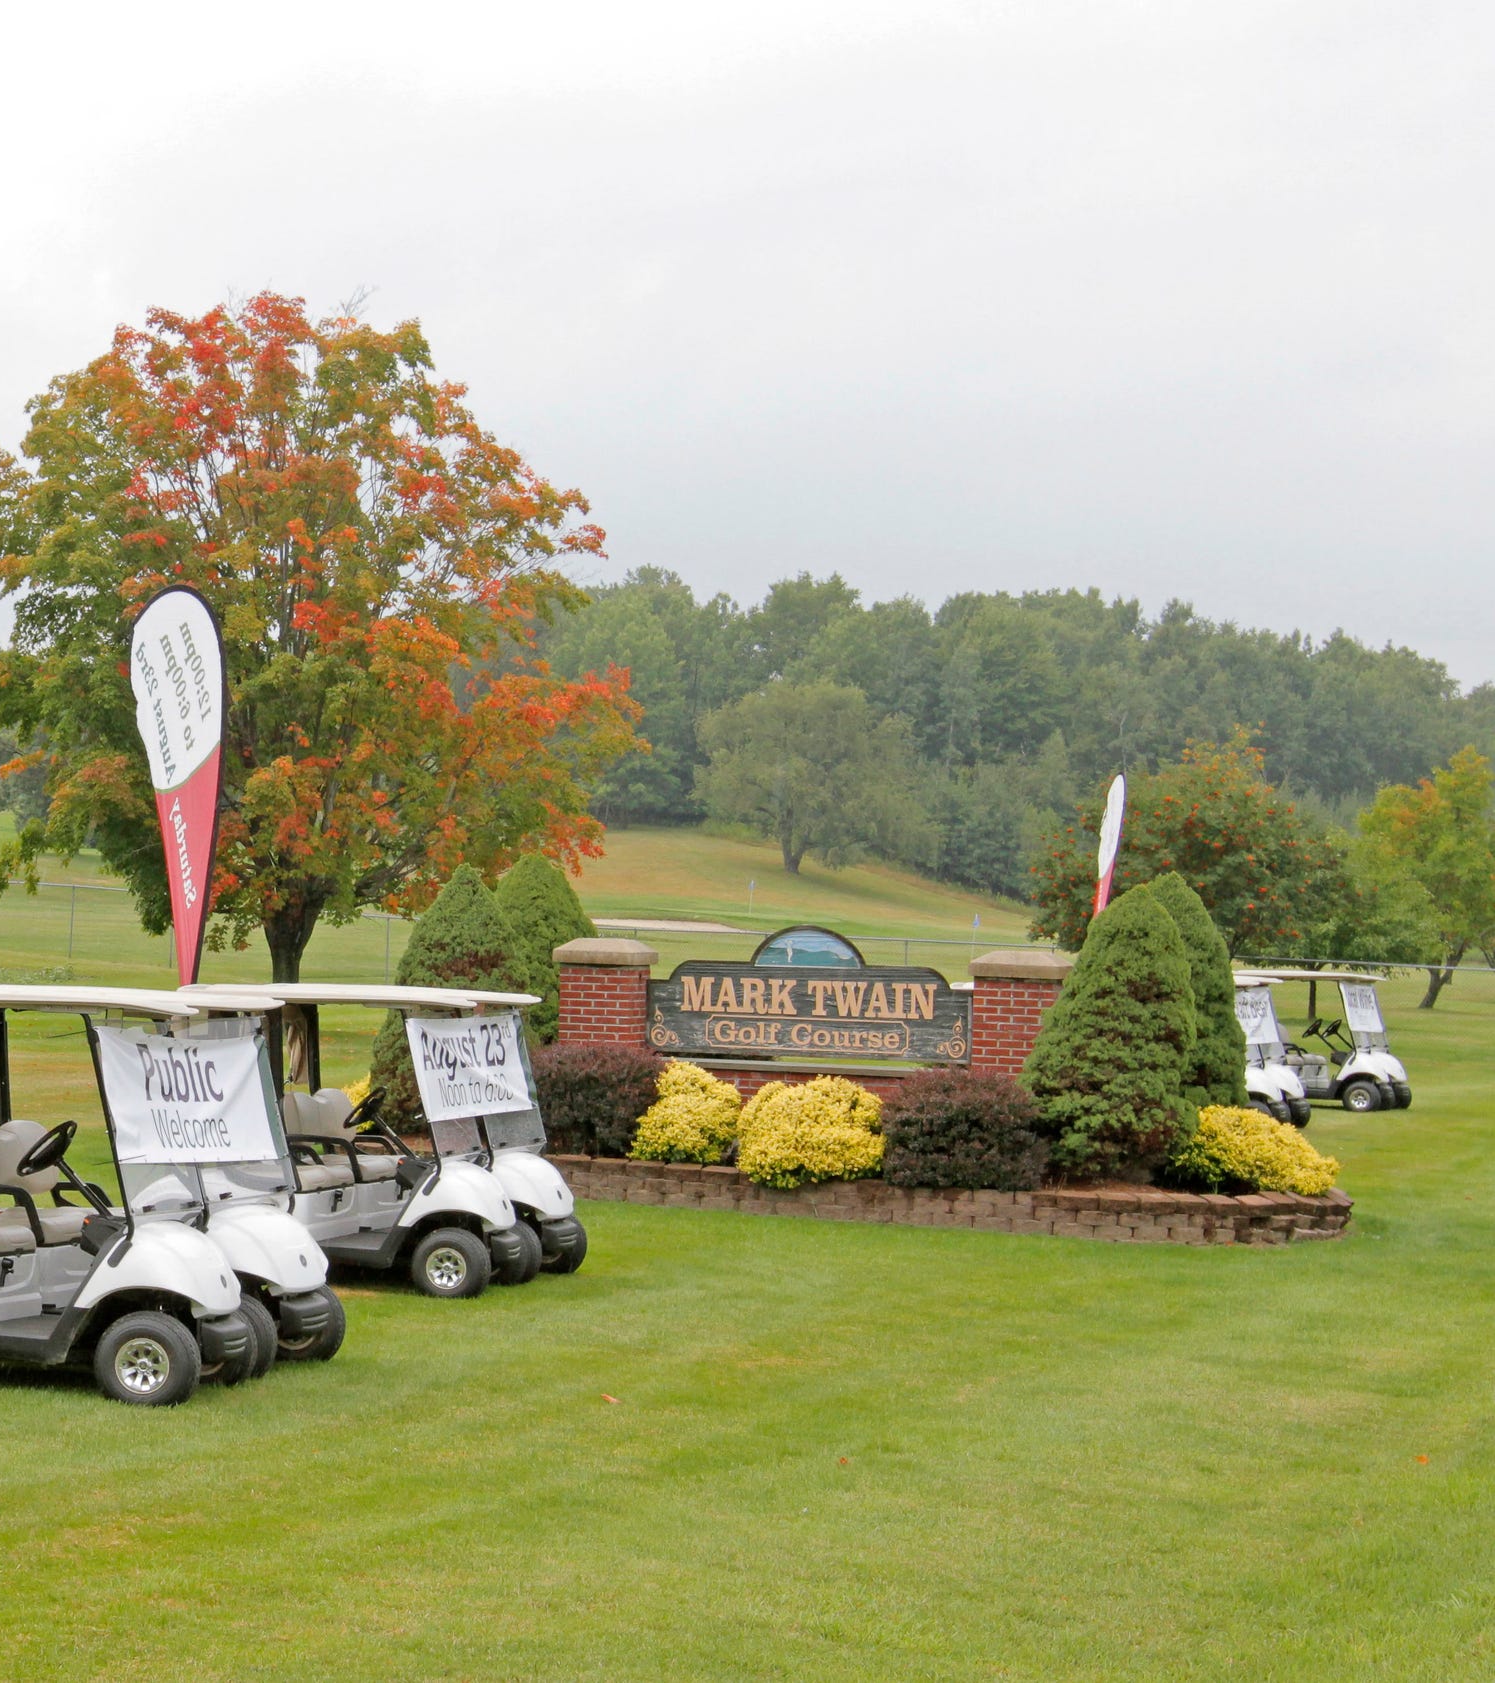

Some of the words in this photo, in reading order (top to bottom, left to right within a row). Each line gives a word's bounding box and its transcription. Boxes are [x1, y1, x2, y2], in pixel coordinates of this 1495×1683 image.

[680, 976, 797, 1016] MARK
[807, 980, 937, 1020] TWAIN
[421, 1027, 481, 1081] August
[714, 1020, 781, 1044] Golf
[791, 1024, 900, 1049] Course
[136, 1043, 224, 1102] Public
[438, 1078, 468, 1108] Noon
[469, 1079, 482, 1104] to
[150, 1108, 232, 1149] Welcome
